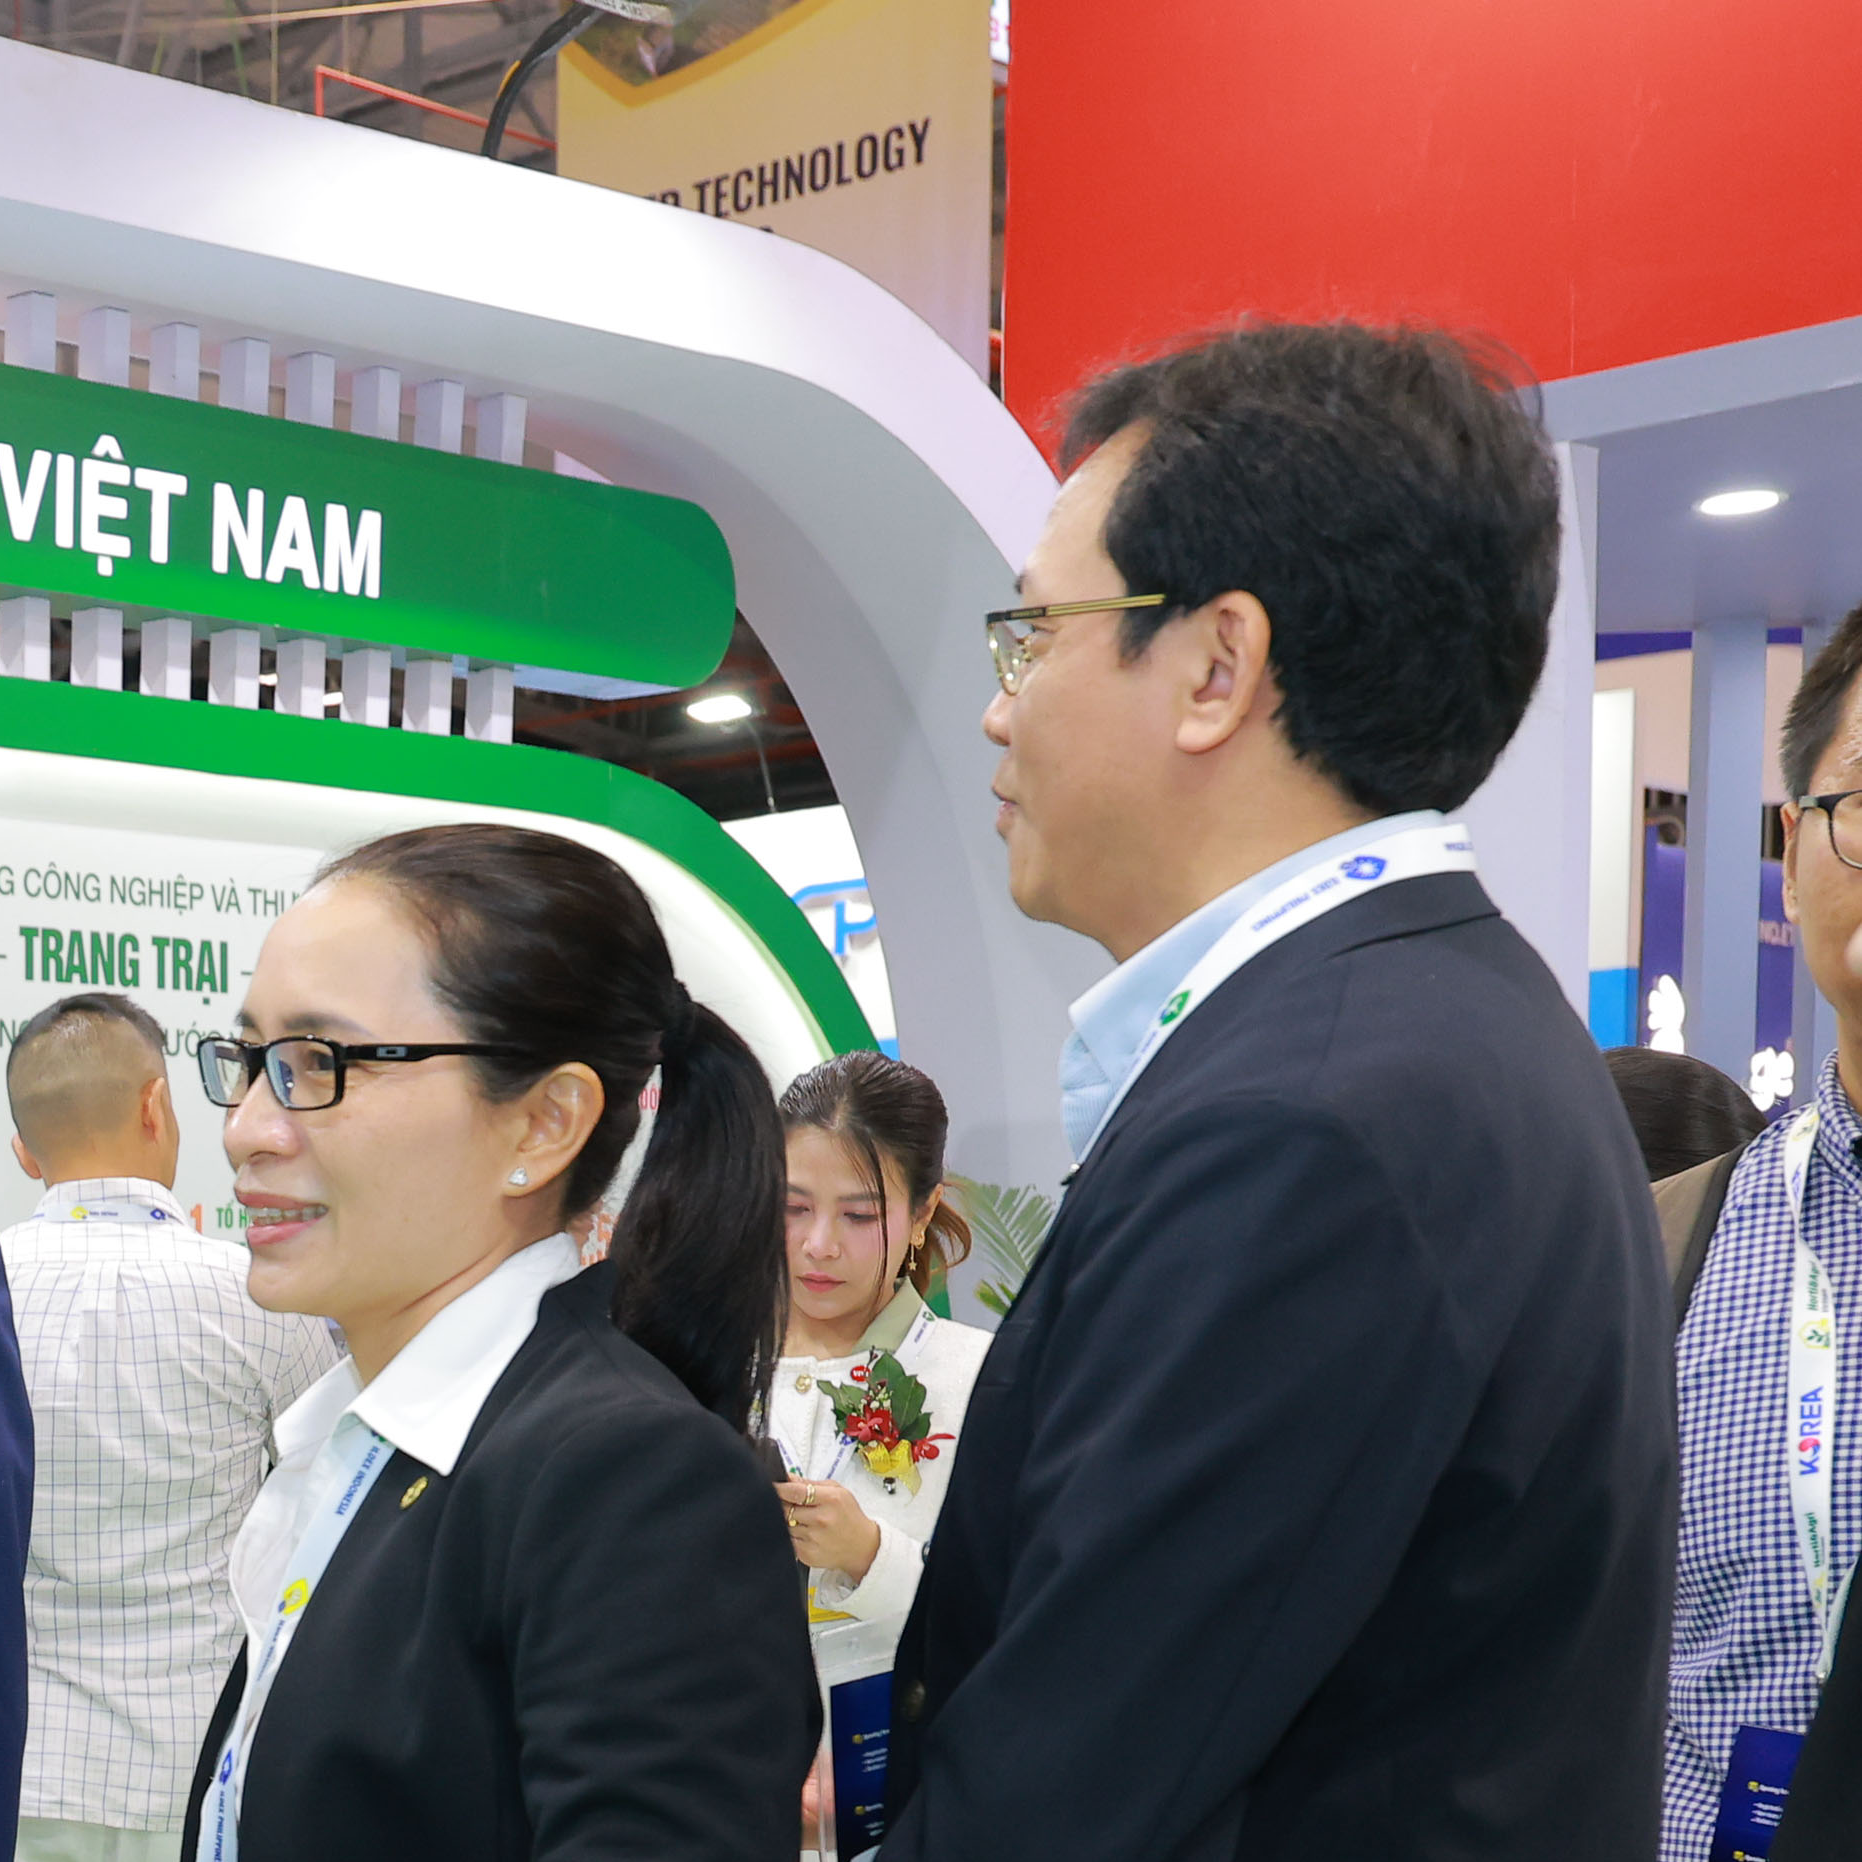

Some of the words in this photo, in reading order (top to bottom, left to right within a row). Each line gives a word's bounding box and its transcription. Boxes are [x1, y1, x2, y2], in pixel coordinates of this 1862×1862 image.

[692, 116, 931, 218] TECHNOLOGY
[211, 482, 383, 600] NAM
[24, 862, 100, 902] CÔNG
[110, 874, 204, 916] NGHIỆP
[212, 878, 241, 914] VÀ
[20, 926, 139, 987] TRANG
[152, 936, 228, 1005] TRẠI
[335, 1472, 368, 1516] INDONESIA
